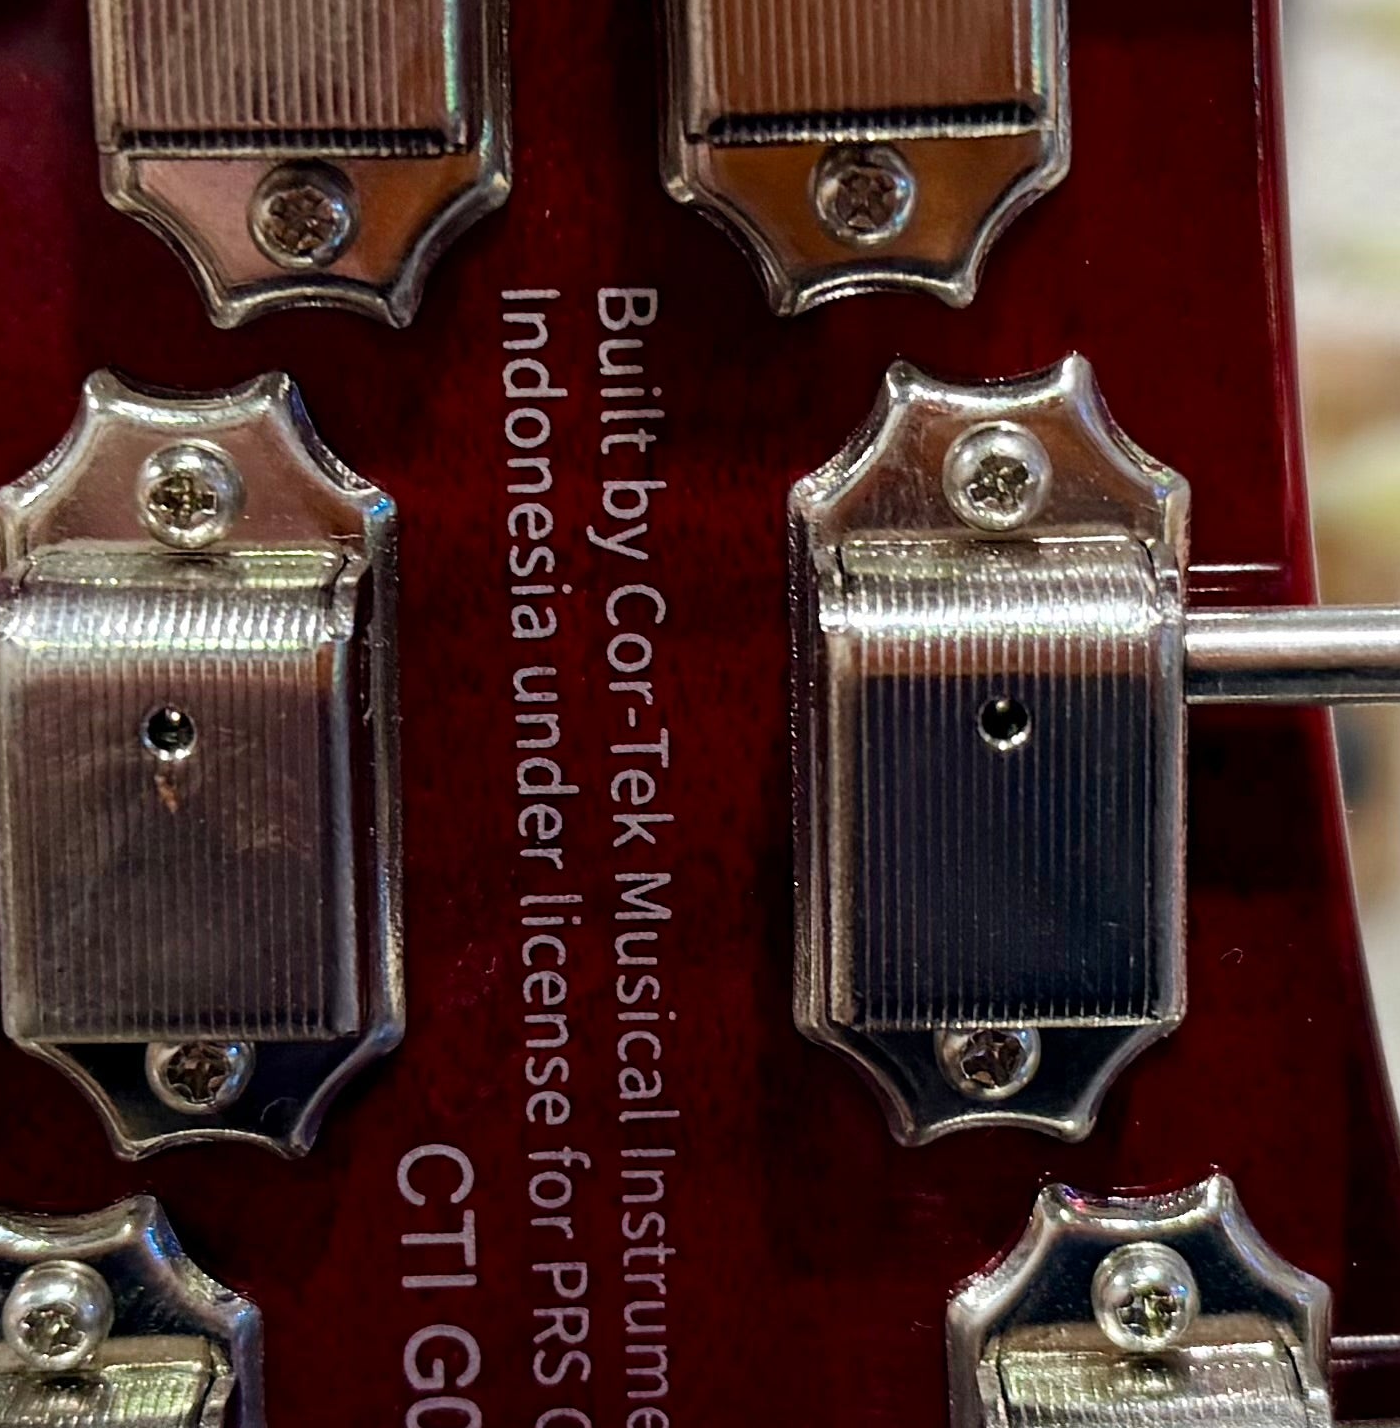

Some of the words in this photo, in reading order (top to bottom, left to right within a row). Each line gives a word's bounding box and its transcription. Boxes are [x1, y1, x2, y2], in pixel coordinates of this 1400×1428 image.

[502, 288, 572, 638] Indonesia
[597, 286, 665, 455] Built
[586, 481, 667, 560] by
[512, 666, 580, 870] under
[605, 584, 674, 846] Cor-Tek
[519, 895, 583, 1124] license
[614, 872, 679, 1122] Musical
[397, 1144, 477, 1288] CTI
[527, 1146, 591, 1239] for
[532, 1262, 591, 1384] PRS
